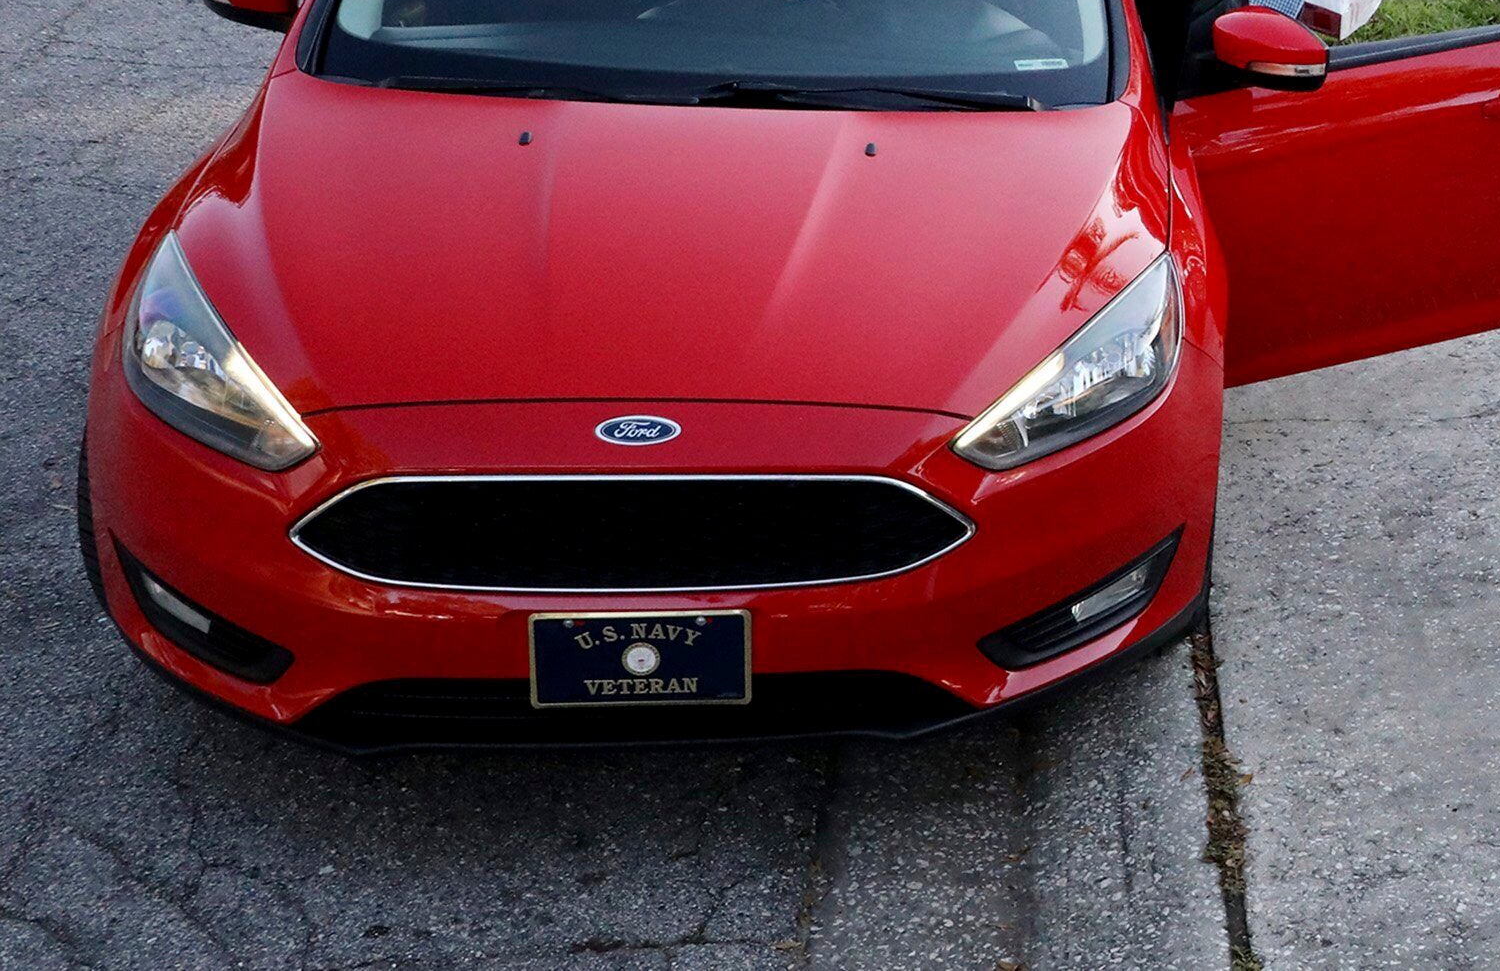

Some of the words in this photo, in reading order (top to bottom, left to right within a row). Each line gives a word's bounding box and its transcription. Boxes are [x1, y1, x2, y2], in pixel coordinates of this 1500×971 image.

[613, 420, 661, 438] Ford
[574, 625, 625, 650] U.S.
[630, 623, 702, 647] NAVY
[583, 677, 699, 696] VETERAN
